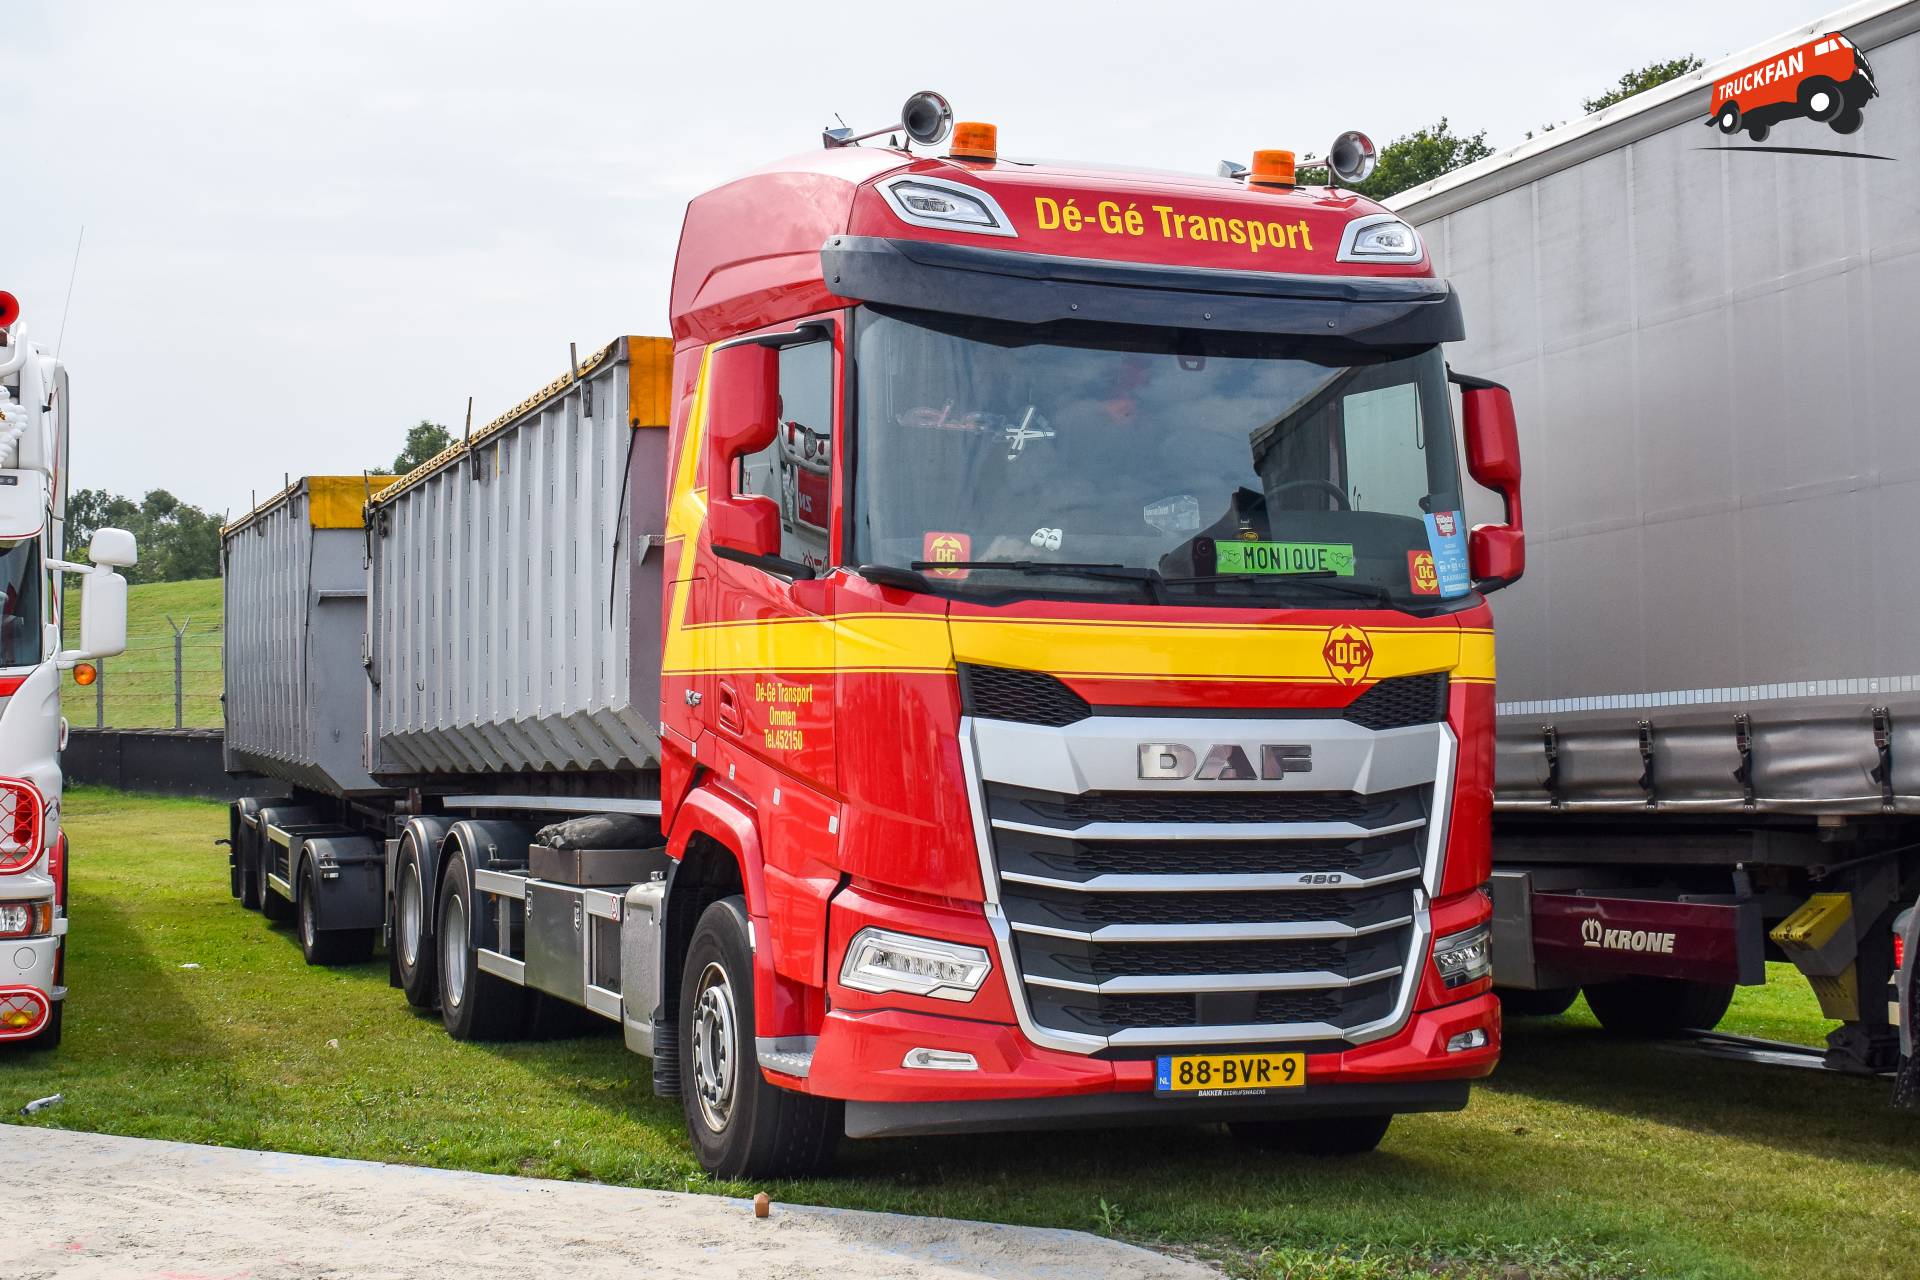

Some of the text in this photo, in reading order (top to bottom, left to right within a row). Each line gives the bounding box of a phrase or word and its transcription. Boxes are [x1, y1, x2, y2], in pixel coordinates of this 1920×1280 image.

[1034, 196, 1313, 253] Dé-Gé Transport
[1243, 546, 1329, 571] MONIQUE
[1335, 642, 1361, 665] DG
[755, 682, 813, 706] Dé-Gé Transport
[769, 706, 797, 727] Ommen
[764, 728, 803, 750] Tel.452150
[1137, 743, 1313, 780] DAF
[1299, 874, 1342, 885] 480
[1603, 928, 1676, 953] KRONE
[1159, 1077, 1169, 1085] NL
[1178, 1057, 1297, 1085] 88-BVR-9
[1198, 1089, 1223, 1097] BAKKER
